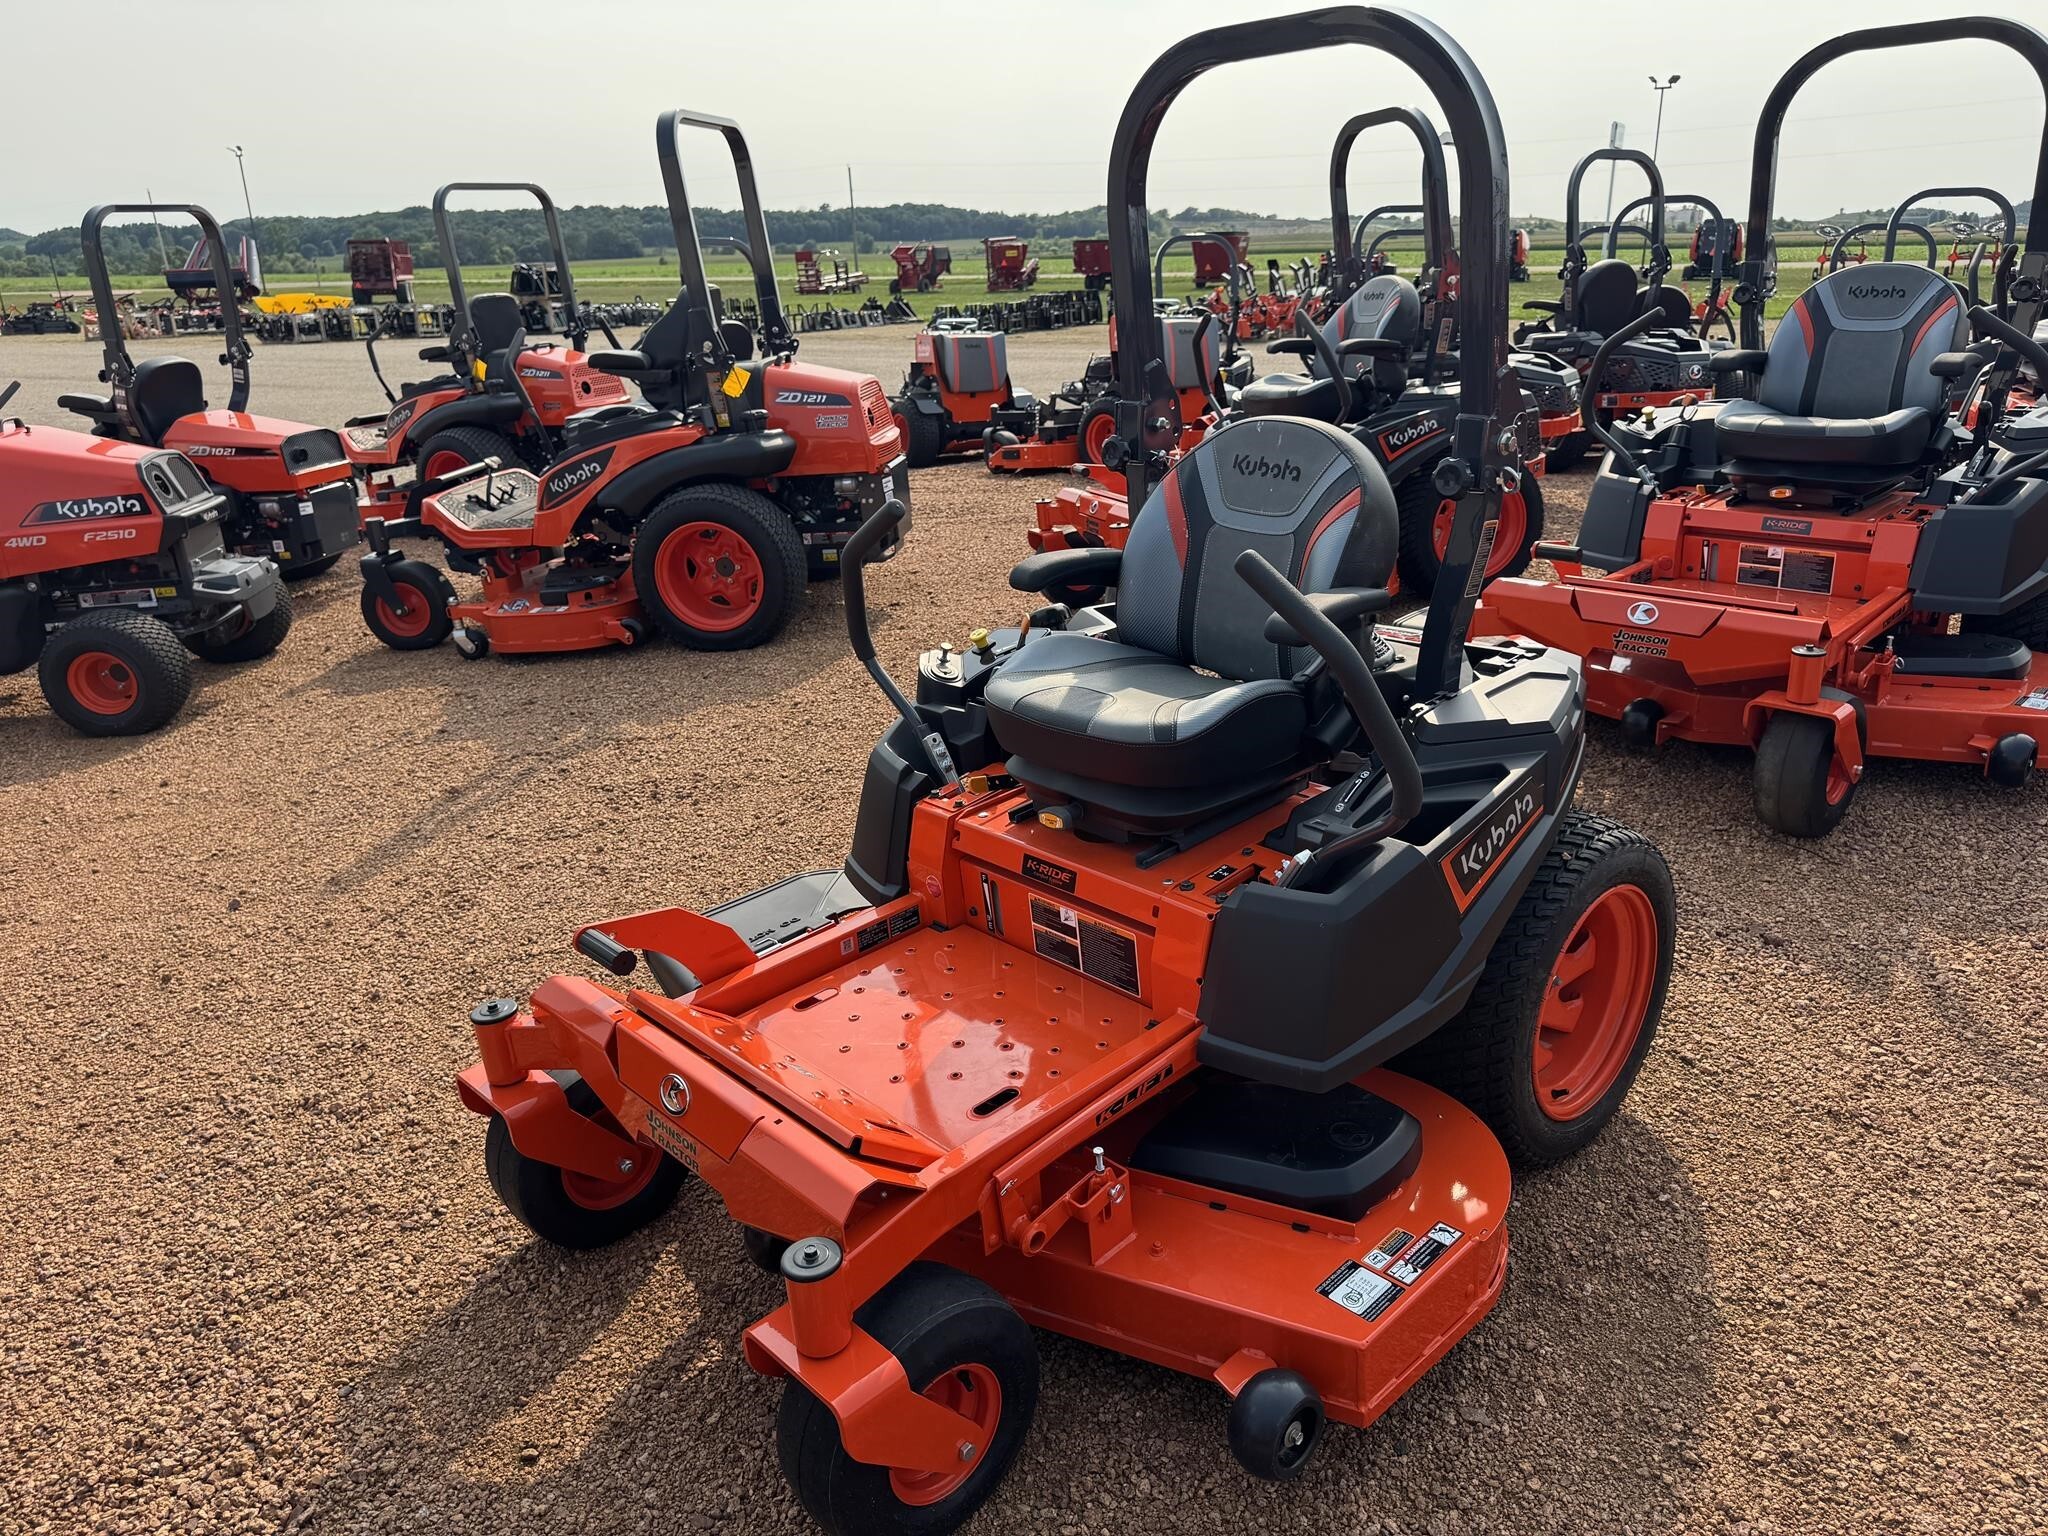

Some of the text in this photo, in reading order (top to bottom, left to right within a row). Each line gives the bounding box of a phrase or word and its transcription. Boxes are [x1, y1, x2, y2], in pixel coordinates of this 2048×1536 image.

[1845, 285, 1906, 298] Kubota
[1388, 419, 1438, 445] Kubota
[549, 462, 602, 492] Kubota
[1232, 453, 1301, 482] Kubota
[56, 496, 141, 518] Kubota
[4, 535, 47, 548] 4WD
[83, 528, 137, 542] F2510
[1613, 629, 1669, 645] JOHNSON
[1613, 639, 1667, 656] TRACTOR
[1460, 794, 1534, 875] Kubota
[646, 1109, 698, 1156] JOHNSON
[648, 1122, 701, 1172] TRACTOR
